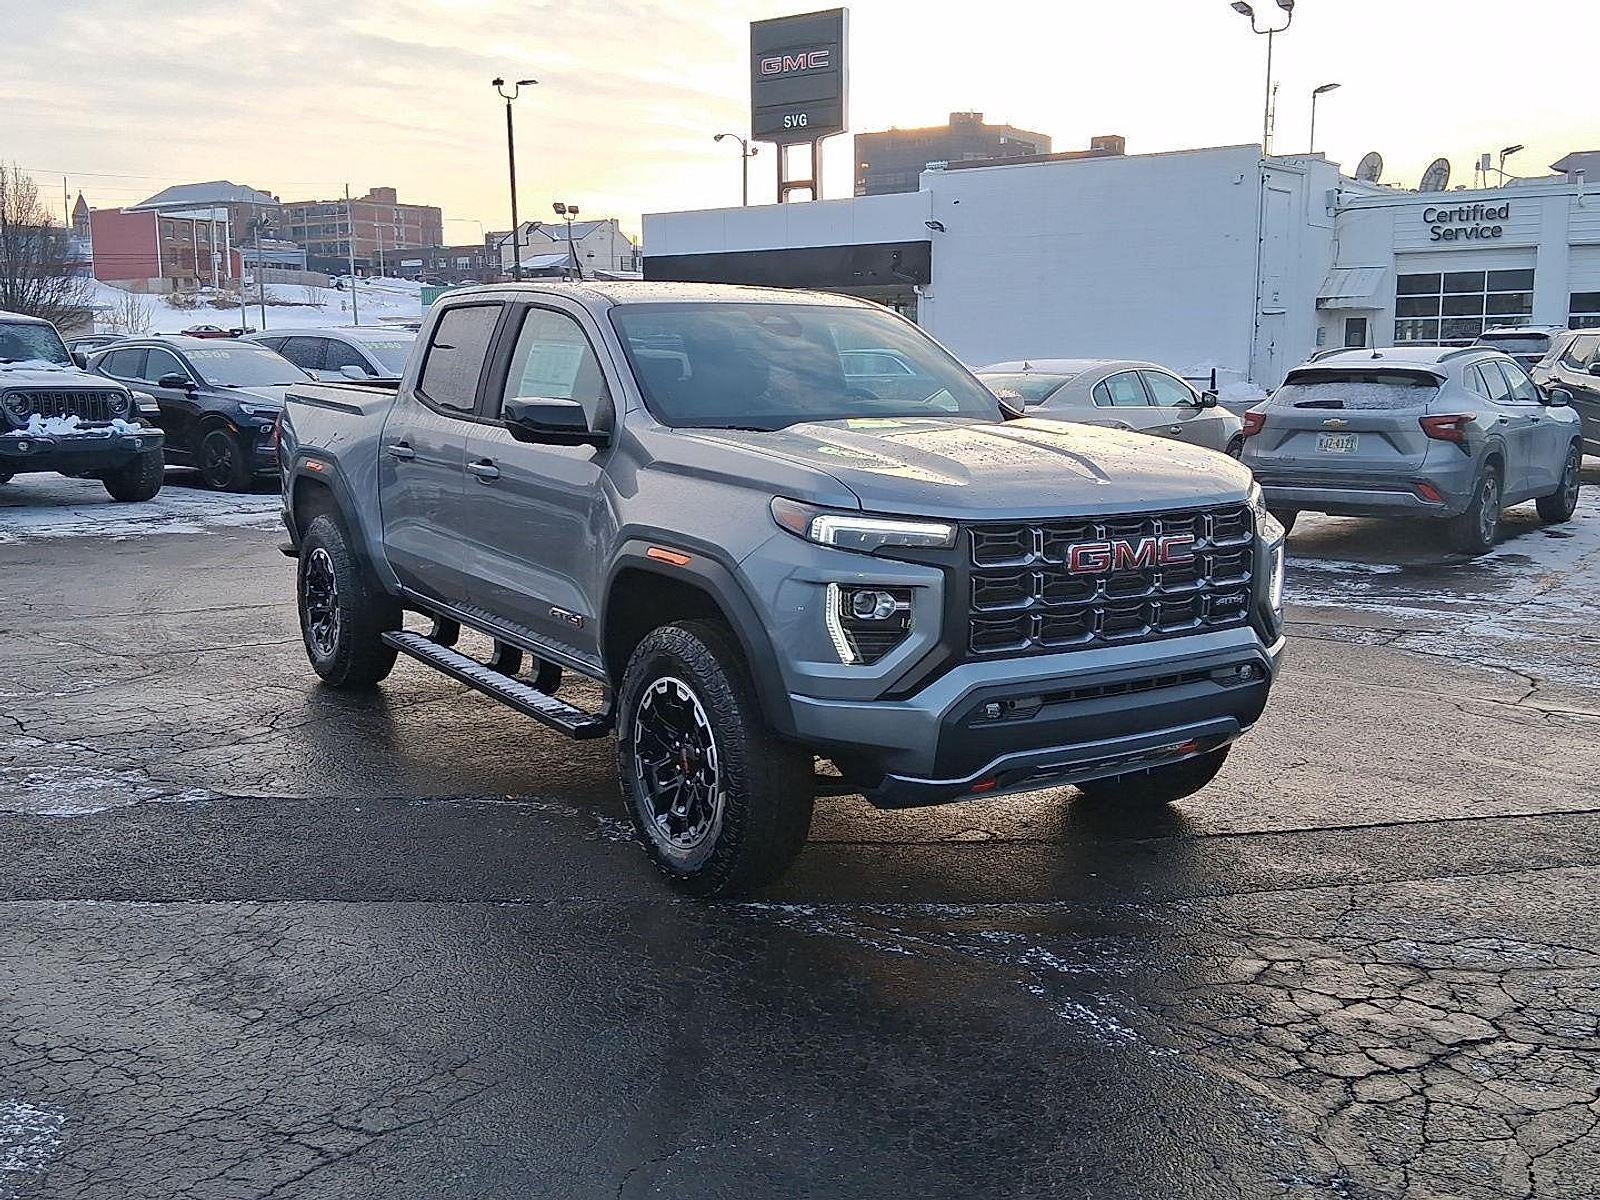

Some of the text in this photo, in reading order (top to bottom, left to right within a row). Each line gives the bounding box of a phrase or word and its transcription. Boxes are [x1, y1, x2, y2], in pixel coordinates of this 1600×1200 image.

[761, 50, 829, 75] GMC
[783, 113, 808, 128] SVG
[1423, 202, 1510, 223] Certified
[1430, 222, 1503, 241] Service
[1066, 534, 1195, 575] GMC
